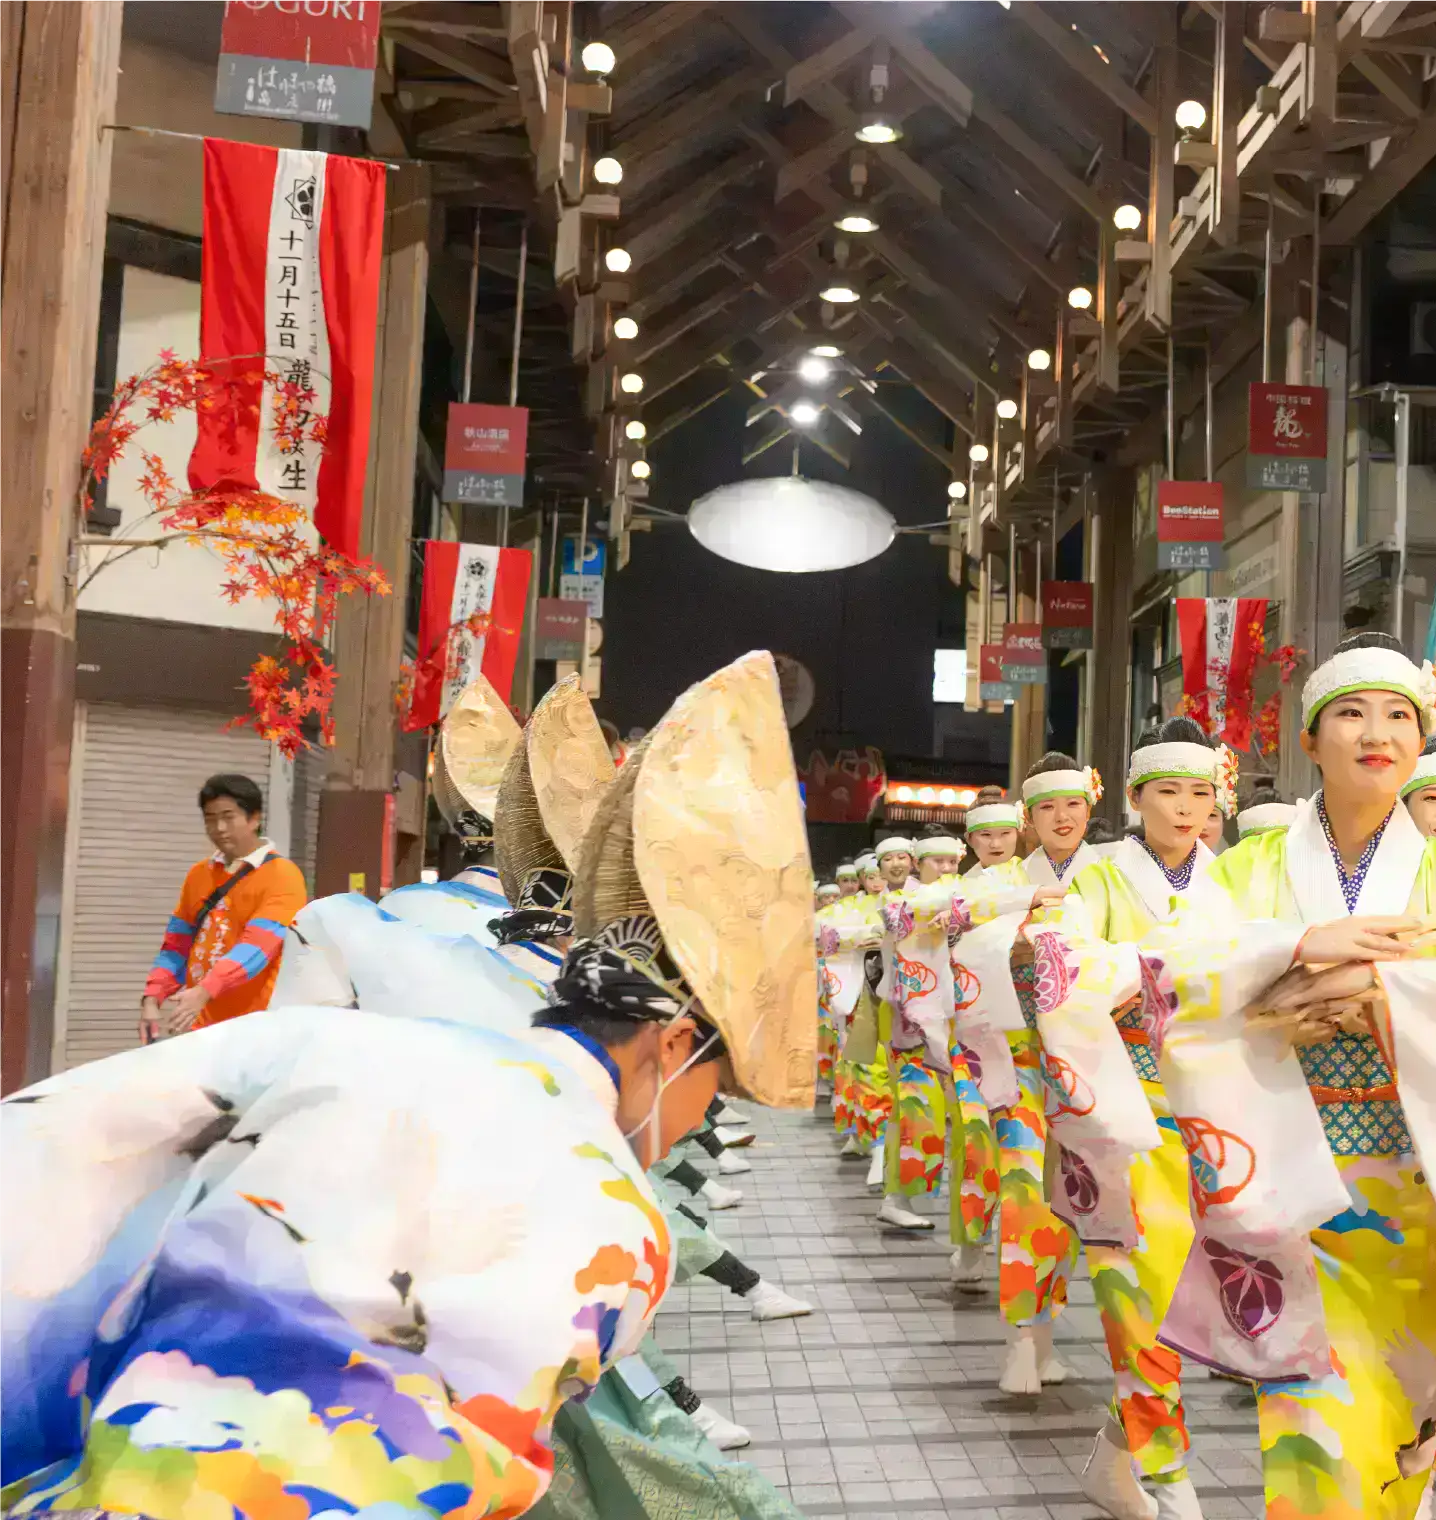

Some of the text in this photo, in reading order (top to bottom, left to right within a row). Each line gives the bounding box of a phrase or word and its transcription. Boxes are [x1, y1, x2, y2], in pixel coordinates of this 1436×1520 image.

[276, 230, 304, 349] 十一月十五日
